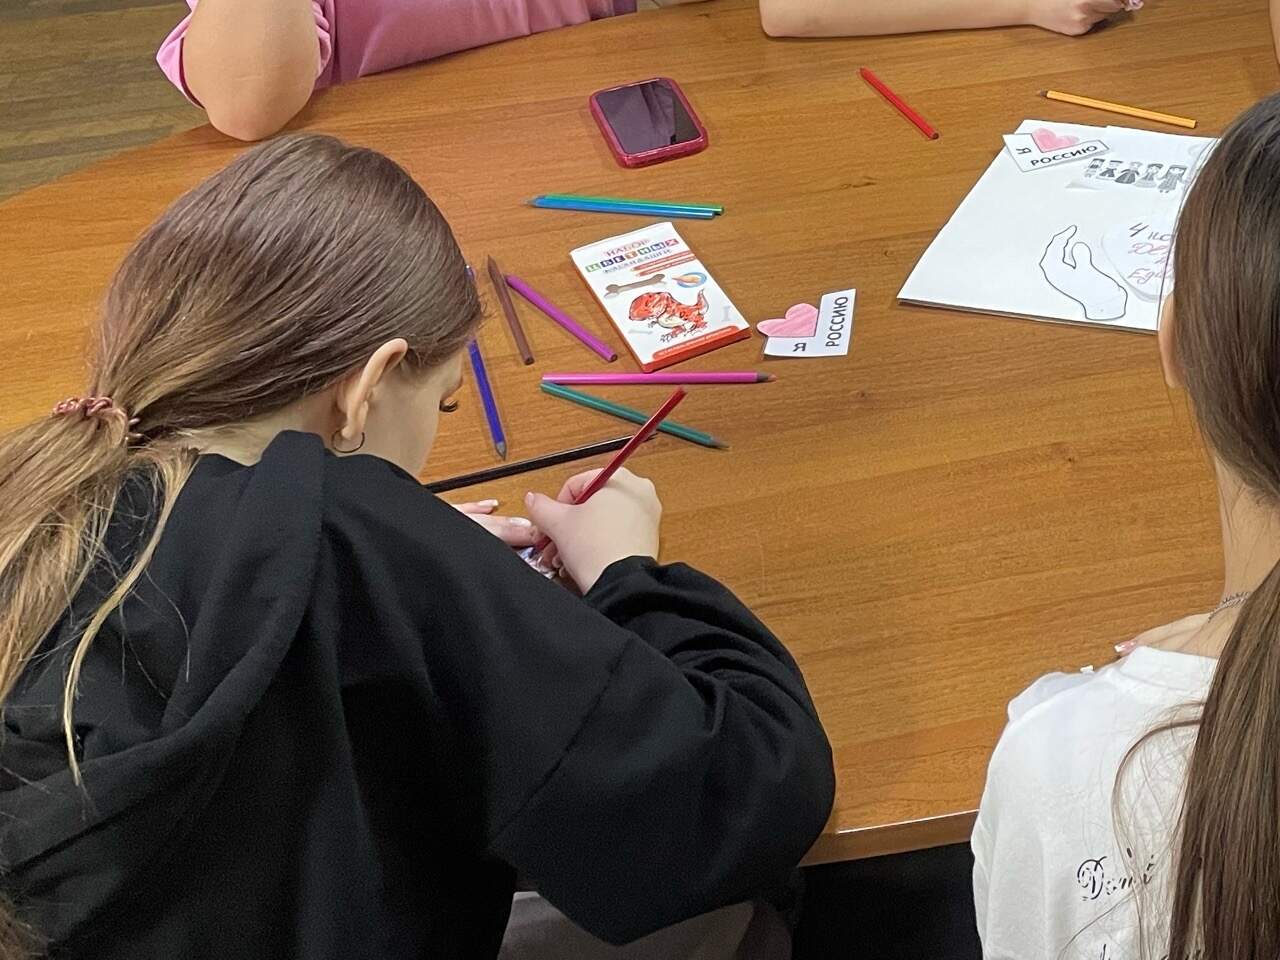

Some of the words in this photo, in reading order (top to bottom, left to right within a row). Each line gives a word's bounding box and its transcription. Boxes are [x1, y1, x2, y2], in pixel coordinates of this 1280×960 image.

[1015, 147, 1032, 155] Я
[1030, 145, 1098, 167] РОССИЮ
[825, 296, 849, 347] РОССИЮ
[793, 342, 807, 352] Я
